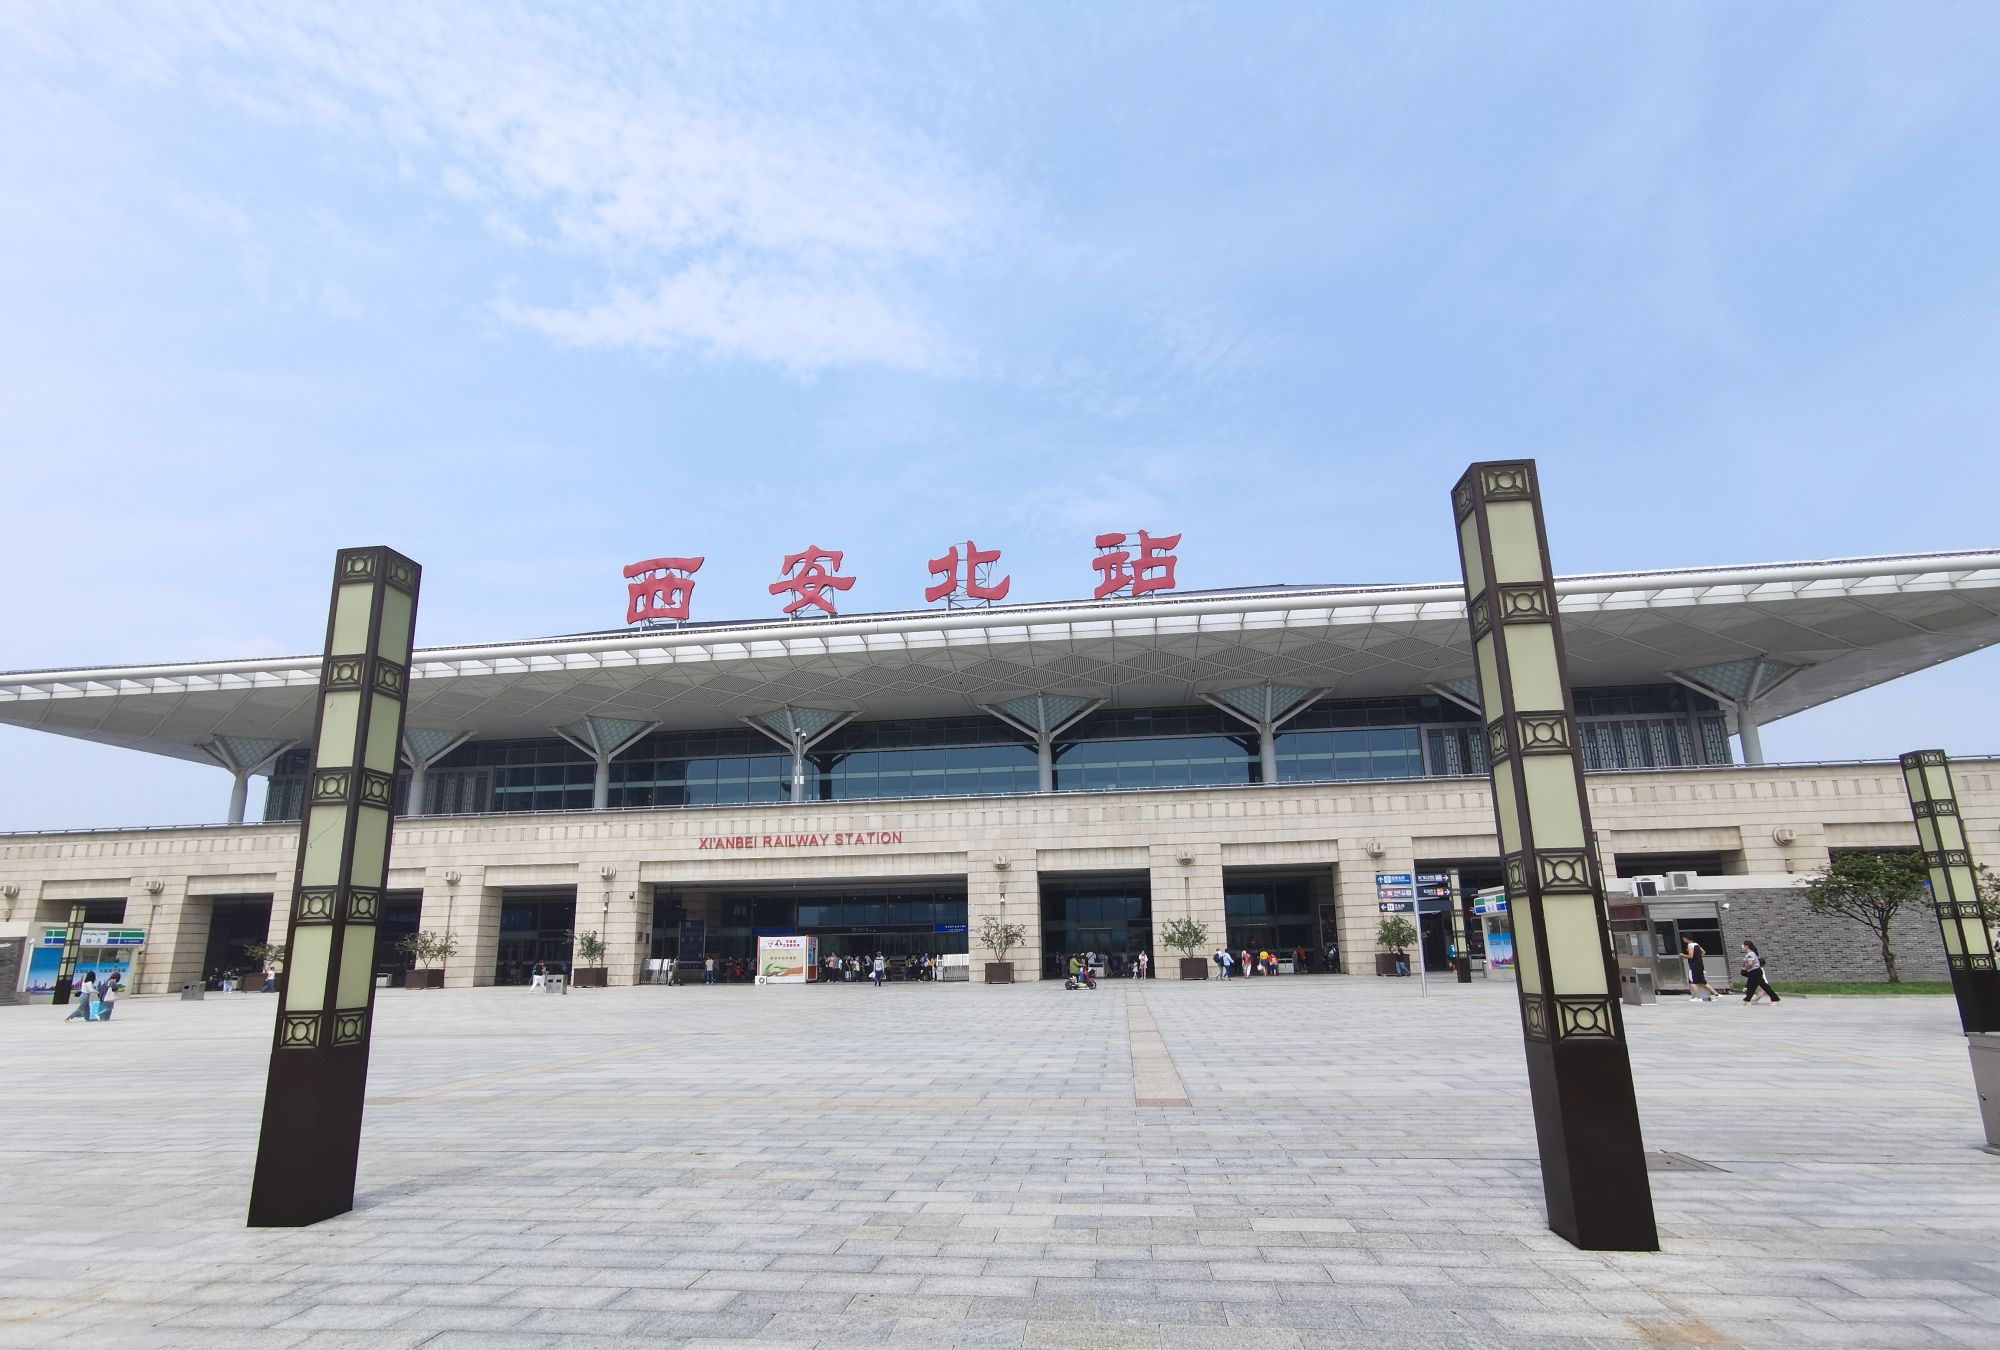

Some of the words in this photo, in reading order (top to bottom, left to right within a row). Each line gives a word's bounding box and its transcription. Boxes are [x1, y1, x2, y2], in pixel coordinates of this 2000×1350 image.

[623, 530, 1181, 625] 西安北站
[699, 836, 757, 849] XI'ANBEI
[763, 834, 828, 848] RAILWAY
[834, 832, 902, 846] STATION
